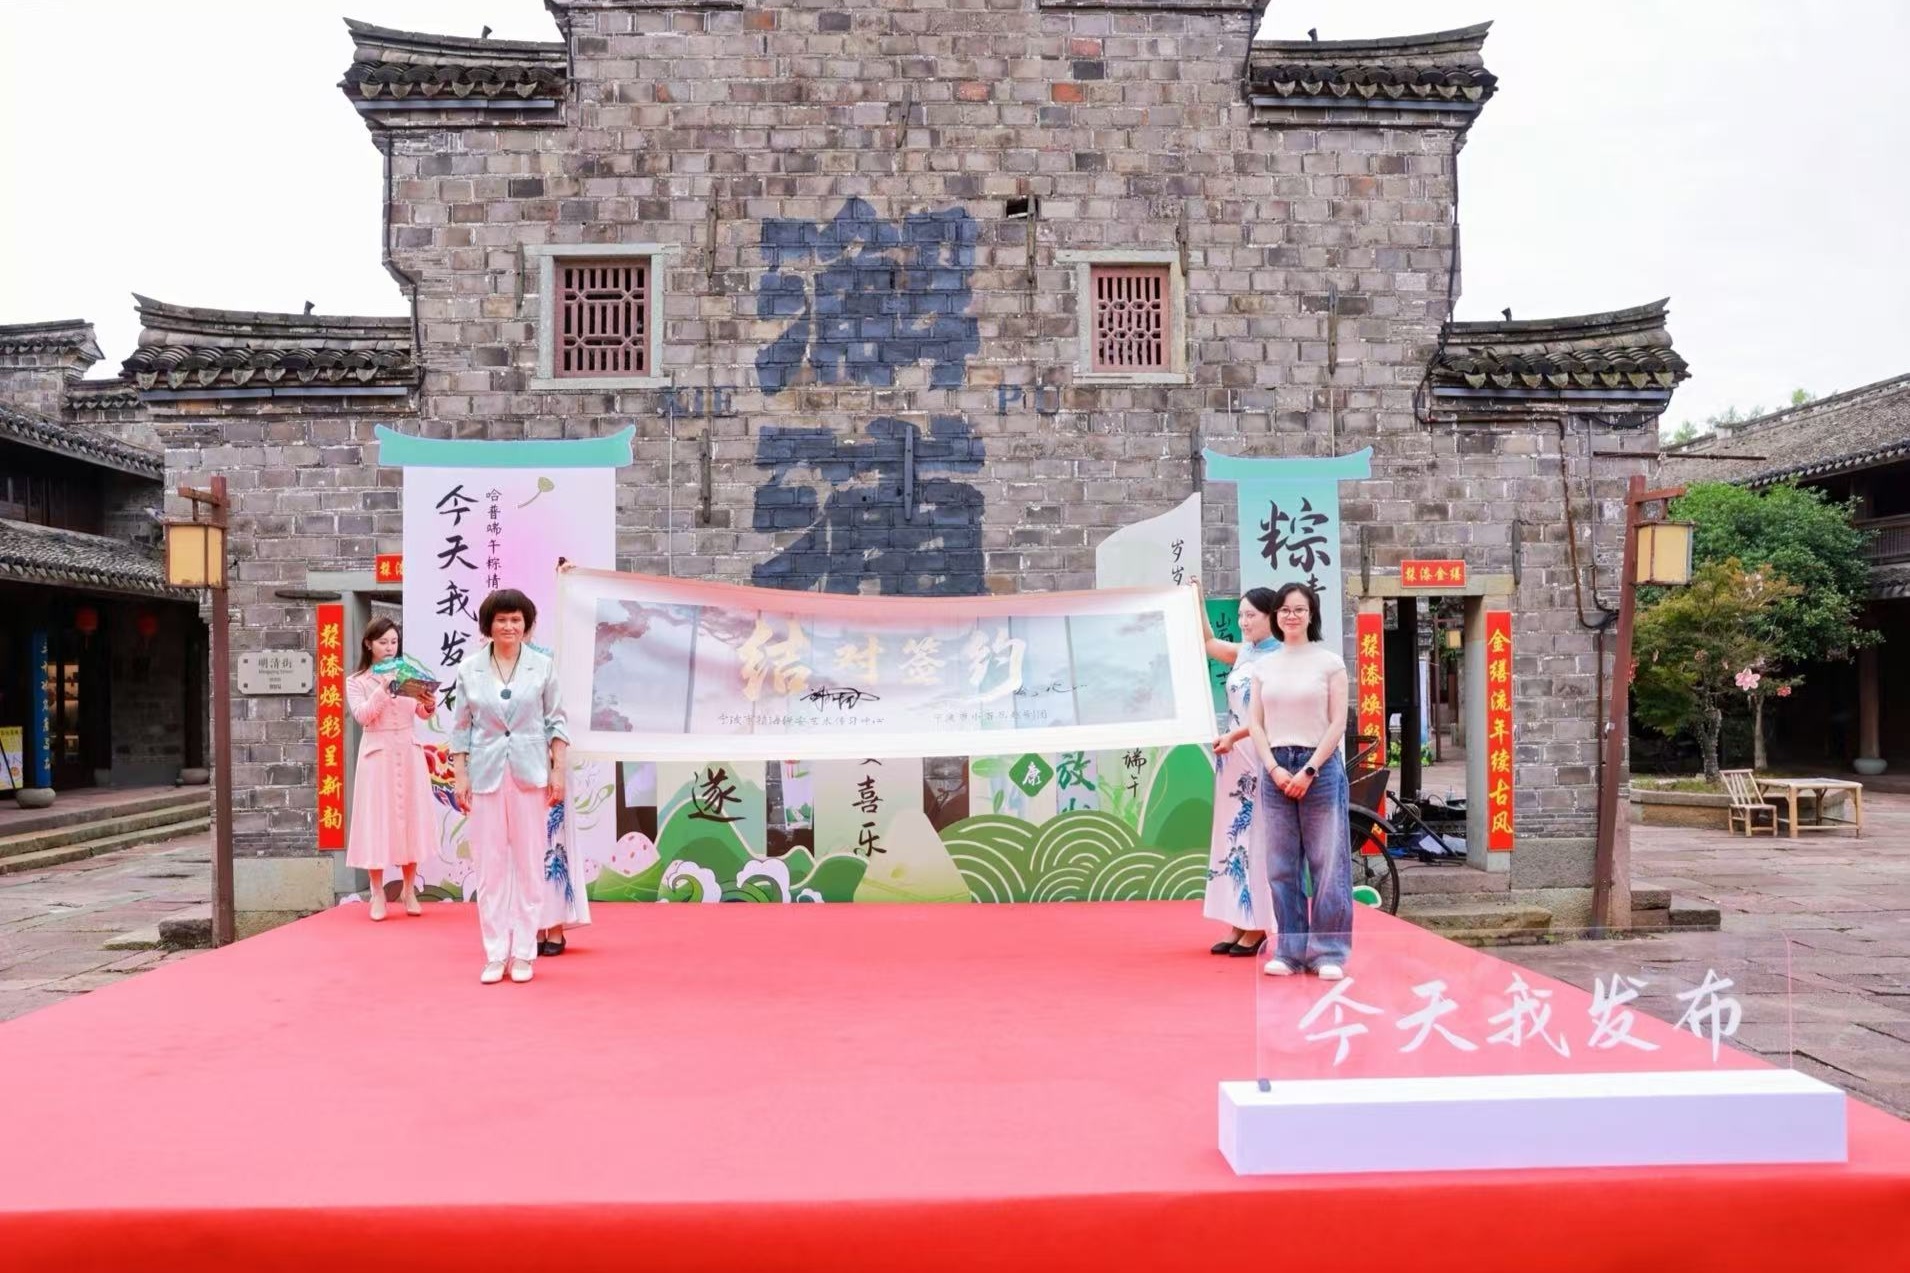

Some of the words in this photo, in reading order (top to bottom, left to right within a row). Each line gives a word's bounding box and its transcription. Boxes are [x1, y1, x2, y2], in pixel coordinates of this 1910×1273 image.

[1171, 538, 1184, 586] 岁岁
[258, 657, 292, 669] 明清街
[735, 616, 1027, 704] 结对签约
[318, 622, 344, 830] 髹漆焕彩呈新韵
[1488, 628, 1514, 834] 金缮流年续古风
[852, 758, 888, 857] 喜乐
[1297, 967, 1743, 1067] 今天我发布
